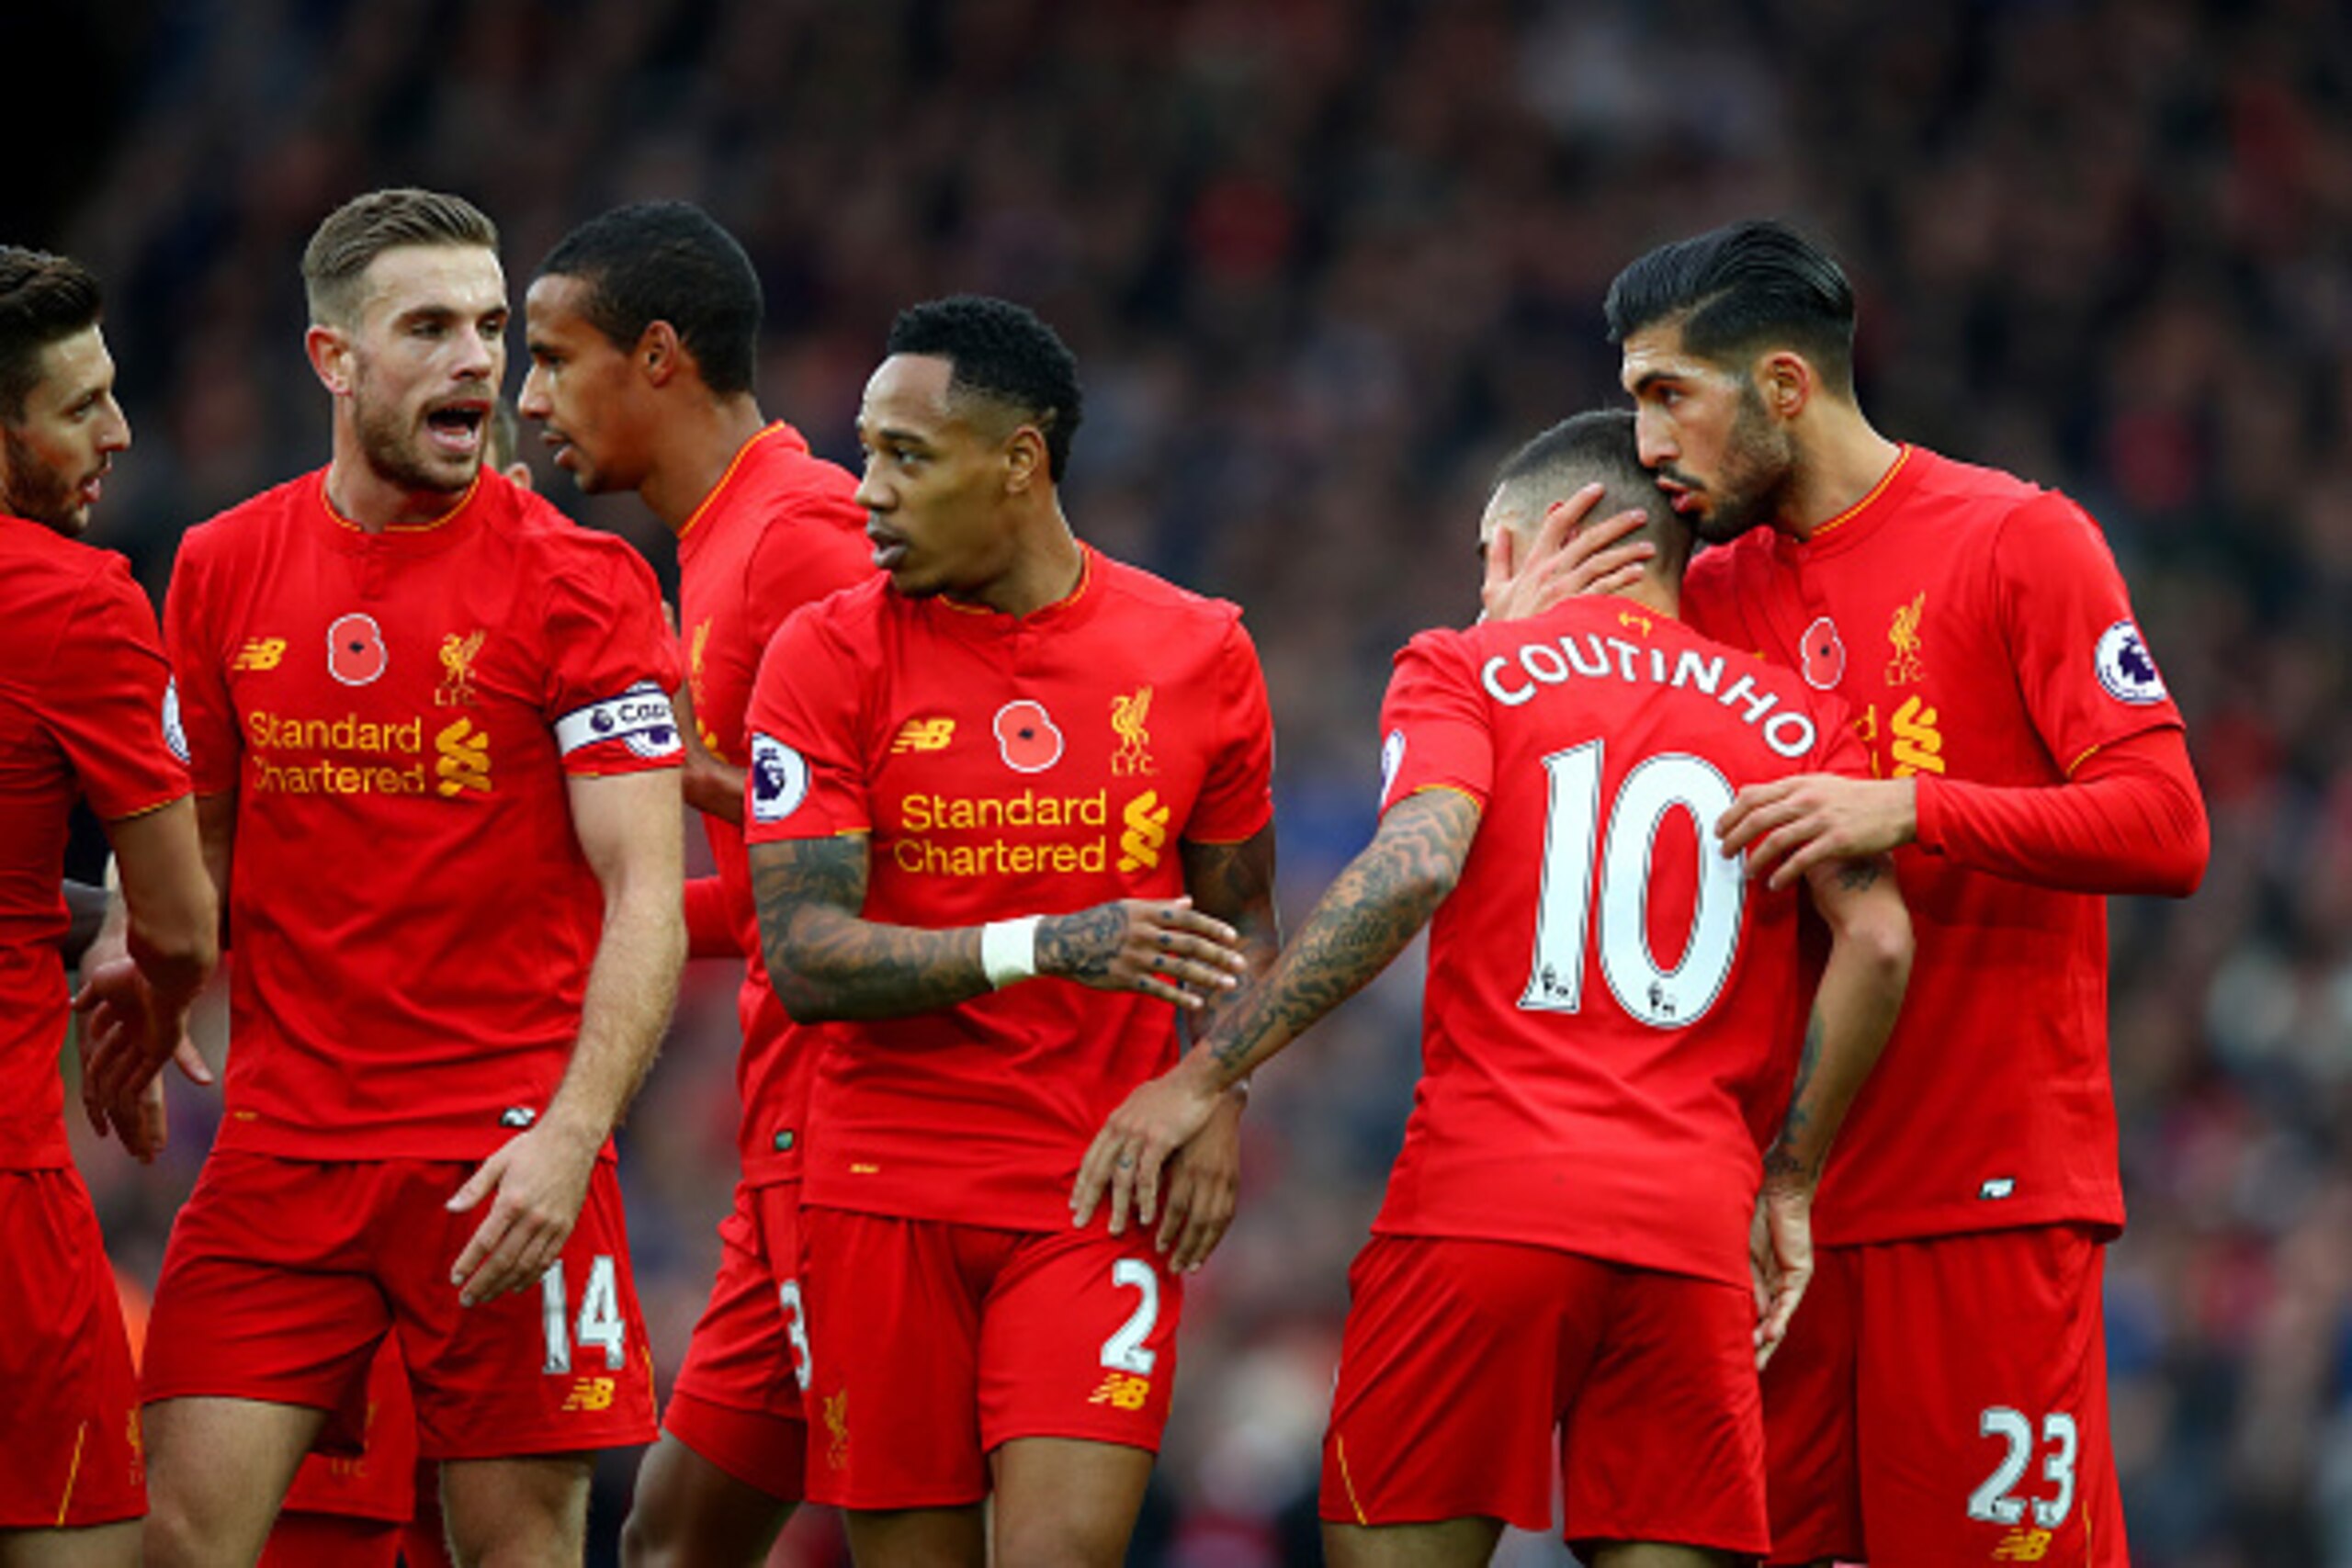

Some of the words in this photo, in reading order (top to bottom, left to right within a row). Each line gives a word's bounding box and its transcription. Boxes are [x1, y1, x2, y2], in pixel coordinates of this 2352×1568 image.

[248, 710, 422, 753] Standard
[1481, 634, 1817, 758] COUTINHO
[893, 834, 1107, 875] Chartered
[901, 786, 1107, 832] Standard
[1516, 737, 1747, 1031] 10
[540, 1254, 627, 1375] 14
[1100, 1258, 1160, 1377] 2
[1965, 1404, 2080, 1529] 23
